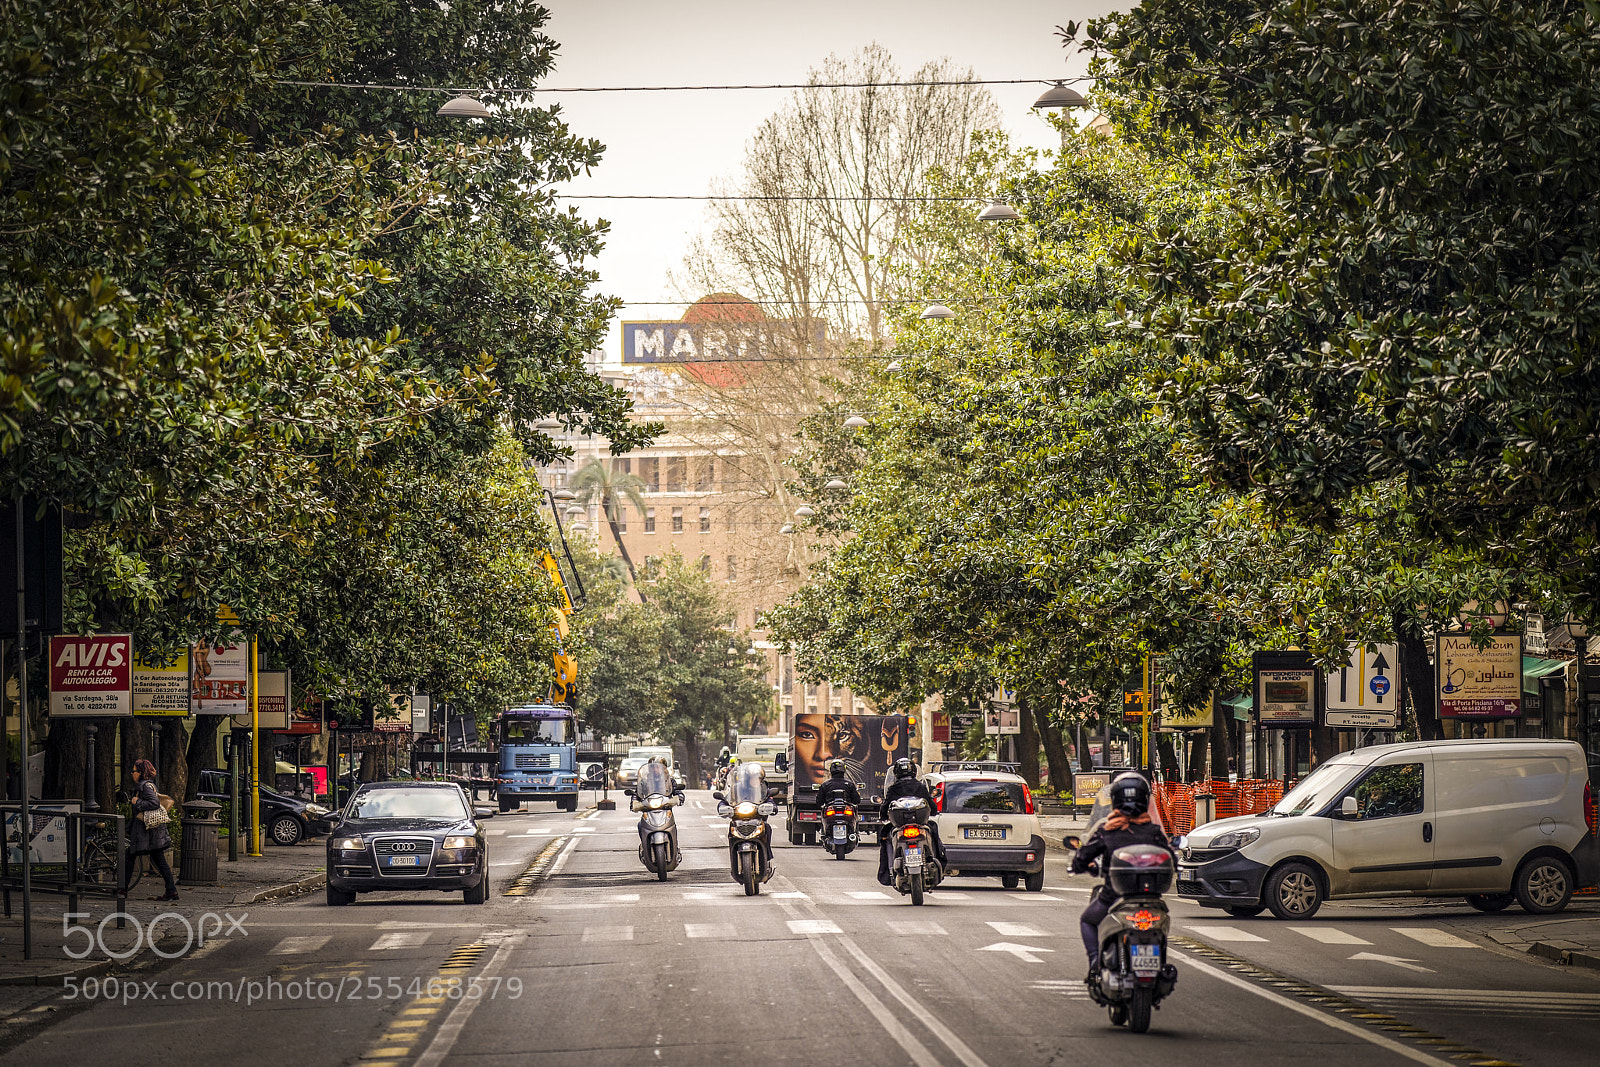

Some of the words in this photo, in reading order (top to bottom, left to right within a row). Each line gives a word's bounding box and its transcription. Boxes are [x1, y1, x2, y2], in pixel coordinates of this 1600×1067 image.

[1444, 638, 1514, 651] Manoun
[55, 642, 126, 667] AVIS
[67, 669, 88, 677] RENT
[62, 677, 117, 685] AUTONOLEGGIO
[73, 695, 104, 703] Sardegna,
[969, 830, 978, 838] EX
